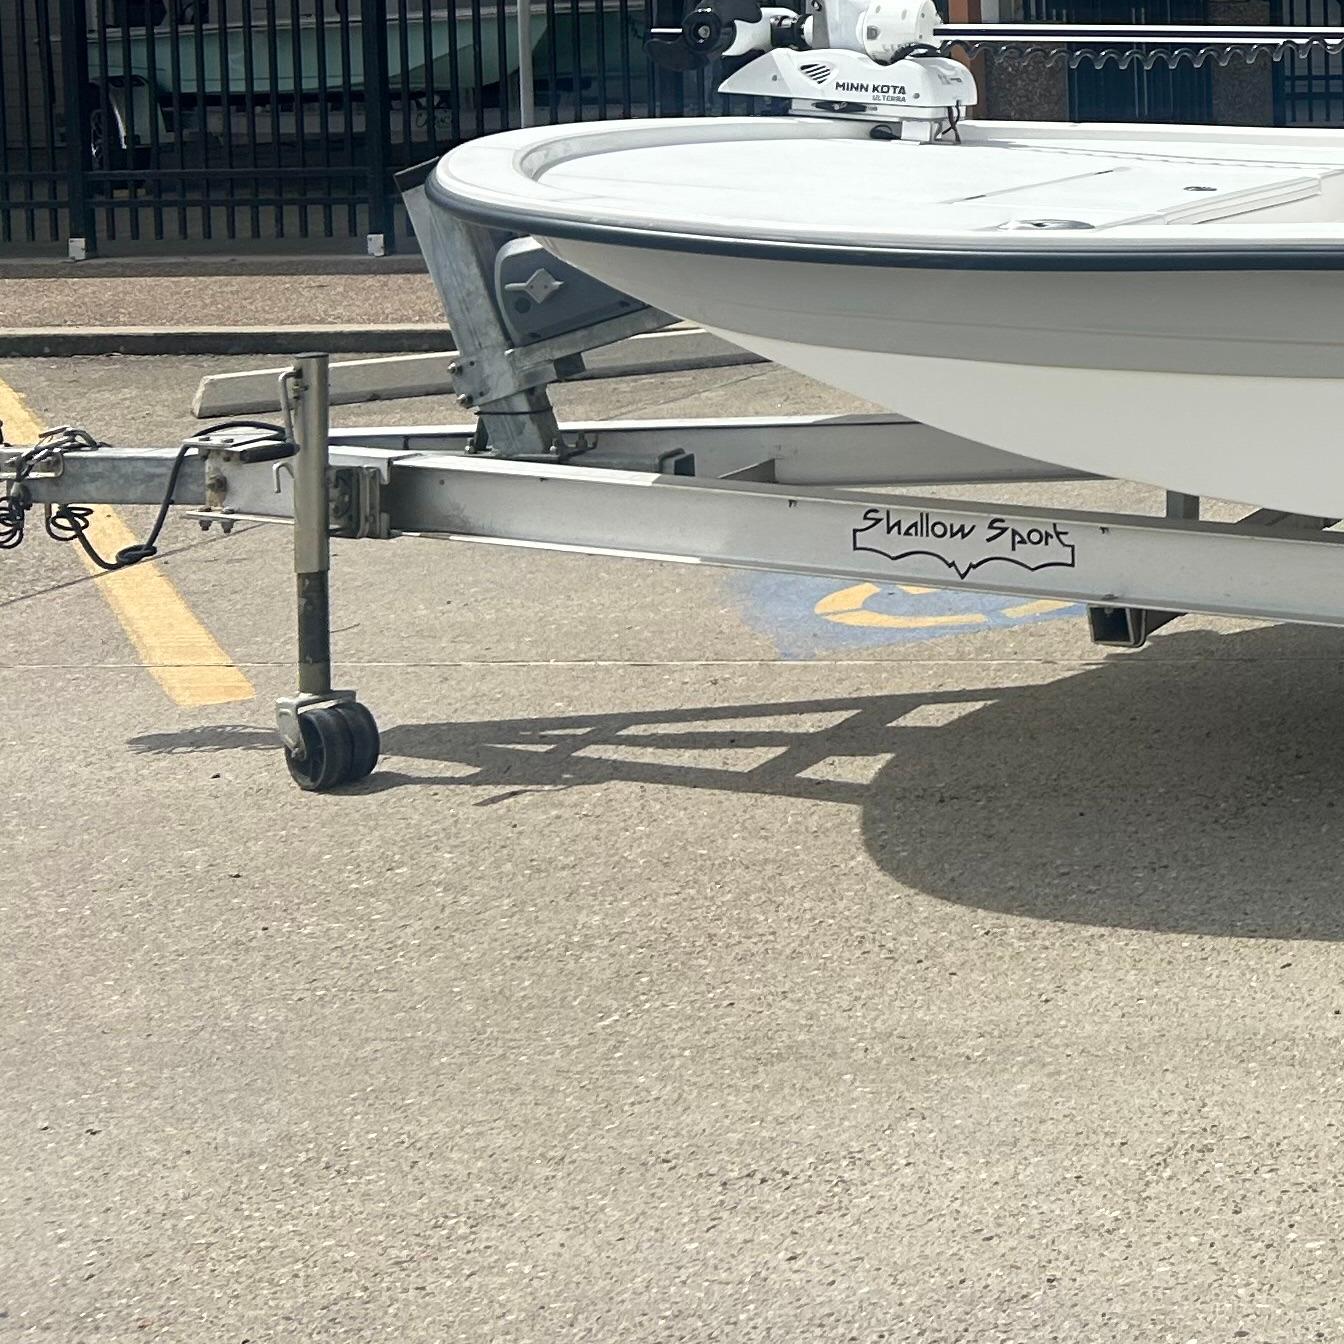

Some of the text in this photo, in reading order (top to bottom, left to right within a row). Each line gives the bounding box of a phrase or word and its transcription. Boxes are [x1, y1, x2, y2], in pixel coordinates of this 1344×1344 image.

[835, 81, 907, 95] MINN KOTA
[856, 508, 1071, 552] Shallow Sport
